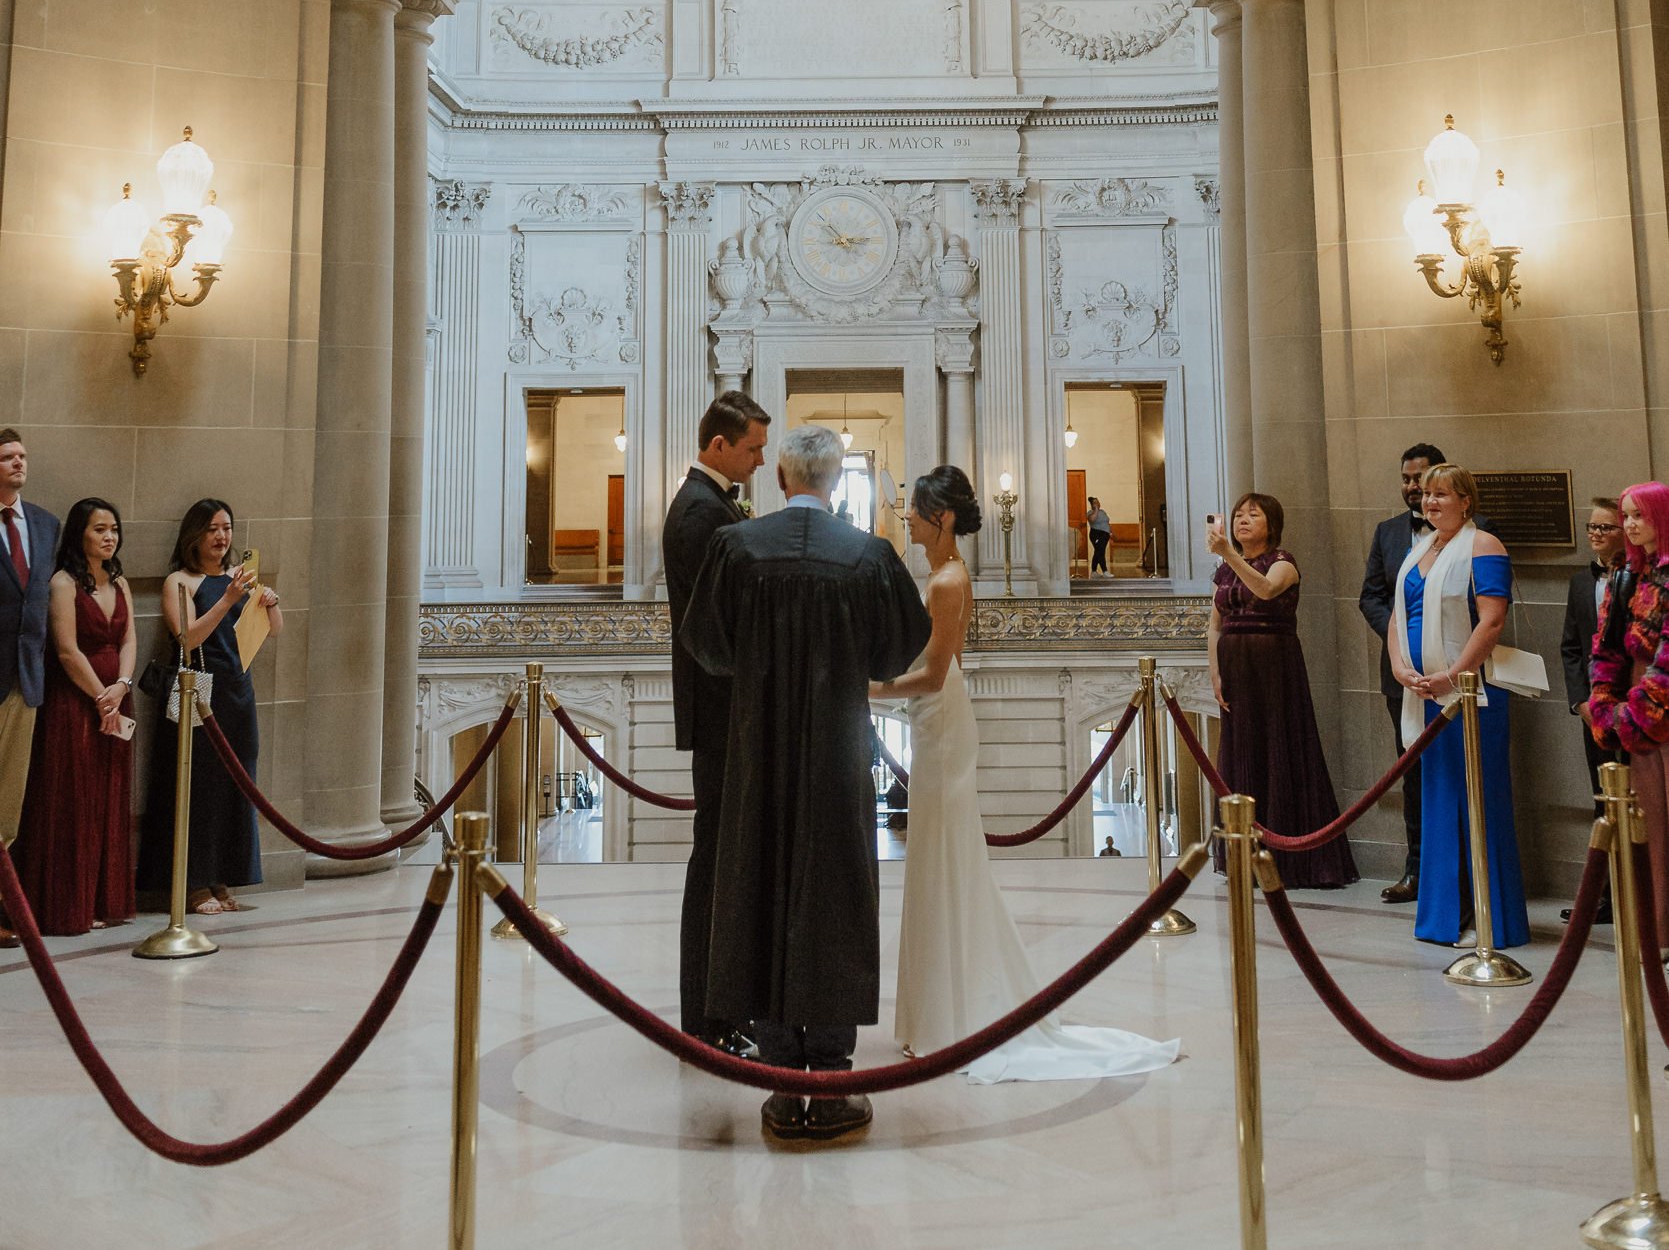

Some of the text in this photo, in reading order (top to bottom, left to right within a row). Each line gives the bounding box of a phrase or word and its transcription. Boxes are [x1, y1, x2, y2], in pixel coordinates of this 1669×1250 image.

[713, 137, 970, 150] 1912 JAMES ROLPH JR. MAYOR 1931
[1520, 475, 1557, 483] ROTUNDA
